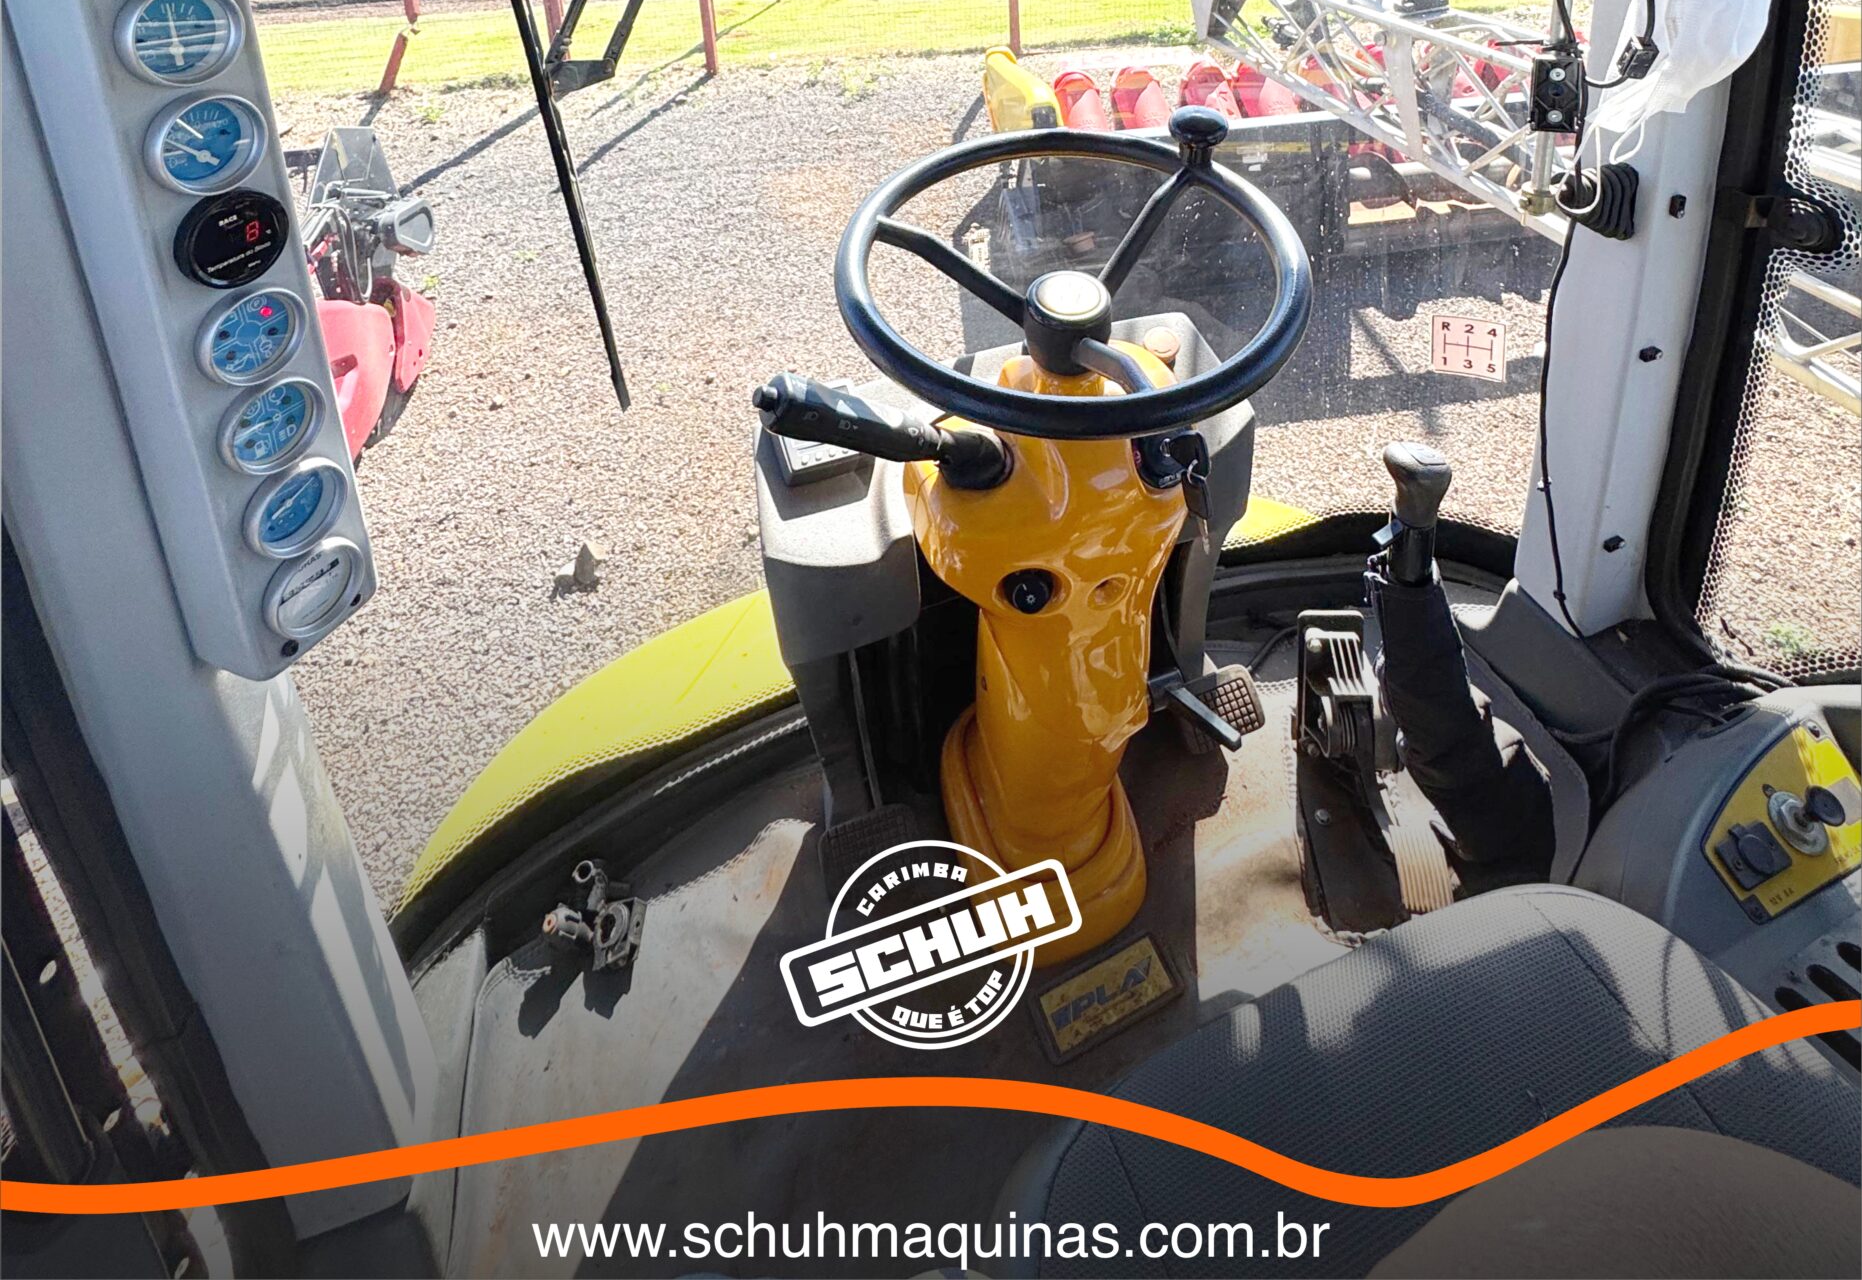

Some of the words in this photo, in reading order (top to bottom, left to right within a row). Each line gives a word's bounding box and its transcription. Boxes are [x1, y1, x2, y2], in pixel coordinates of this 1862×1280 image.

[1441, 321, 1452, 332] R
[1464, 324, 1474, 334] 2
[1487, 328, 1498, 337] 4
[1441, 356, 1448, 366] 1
[1463, 359, 1473, 369] 3
[1486, 363, 1496, 373] 5
